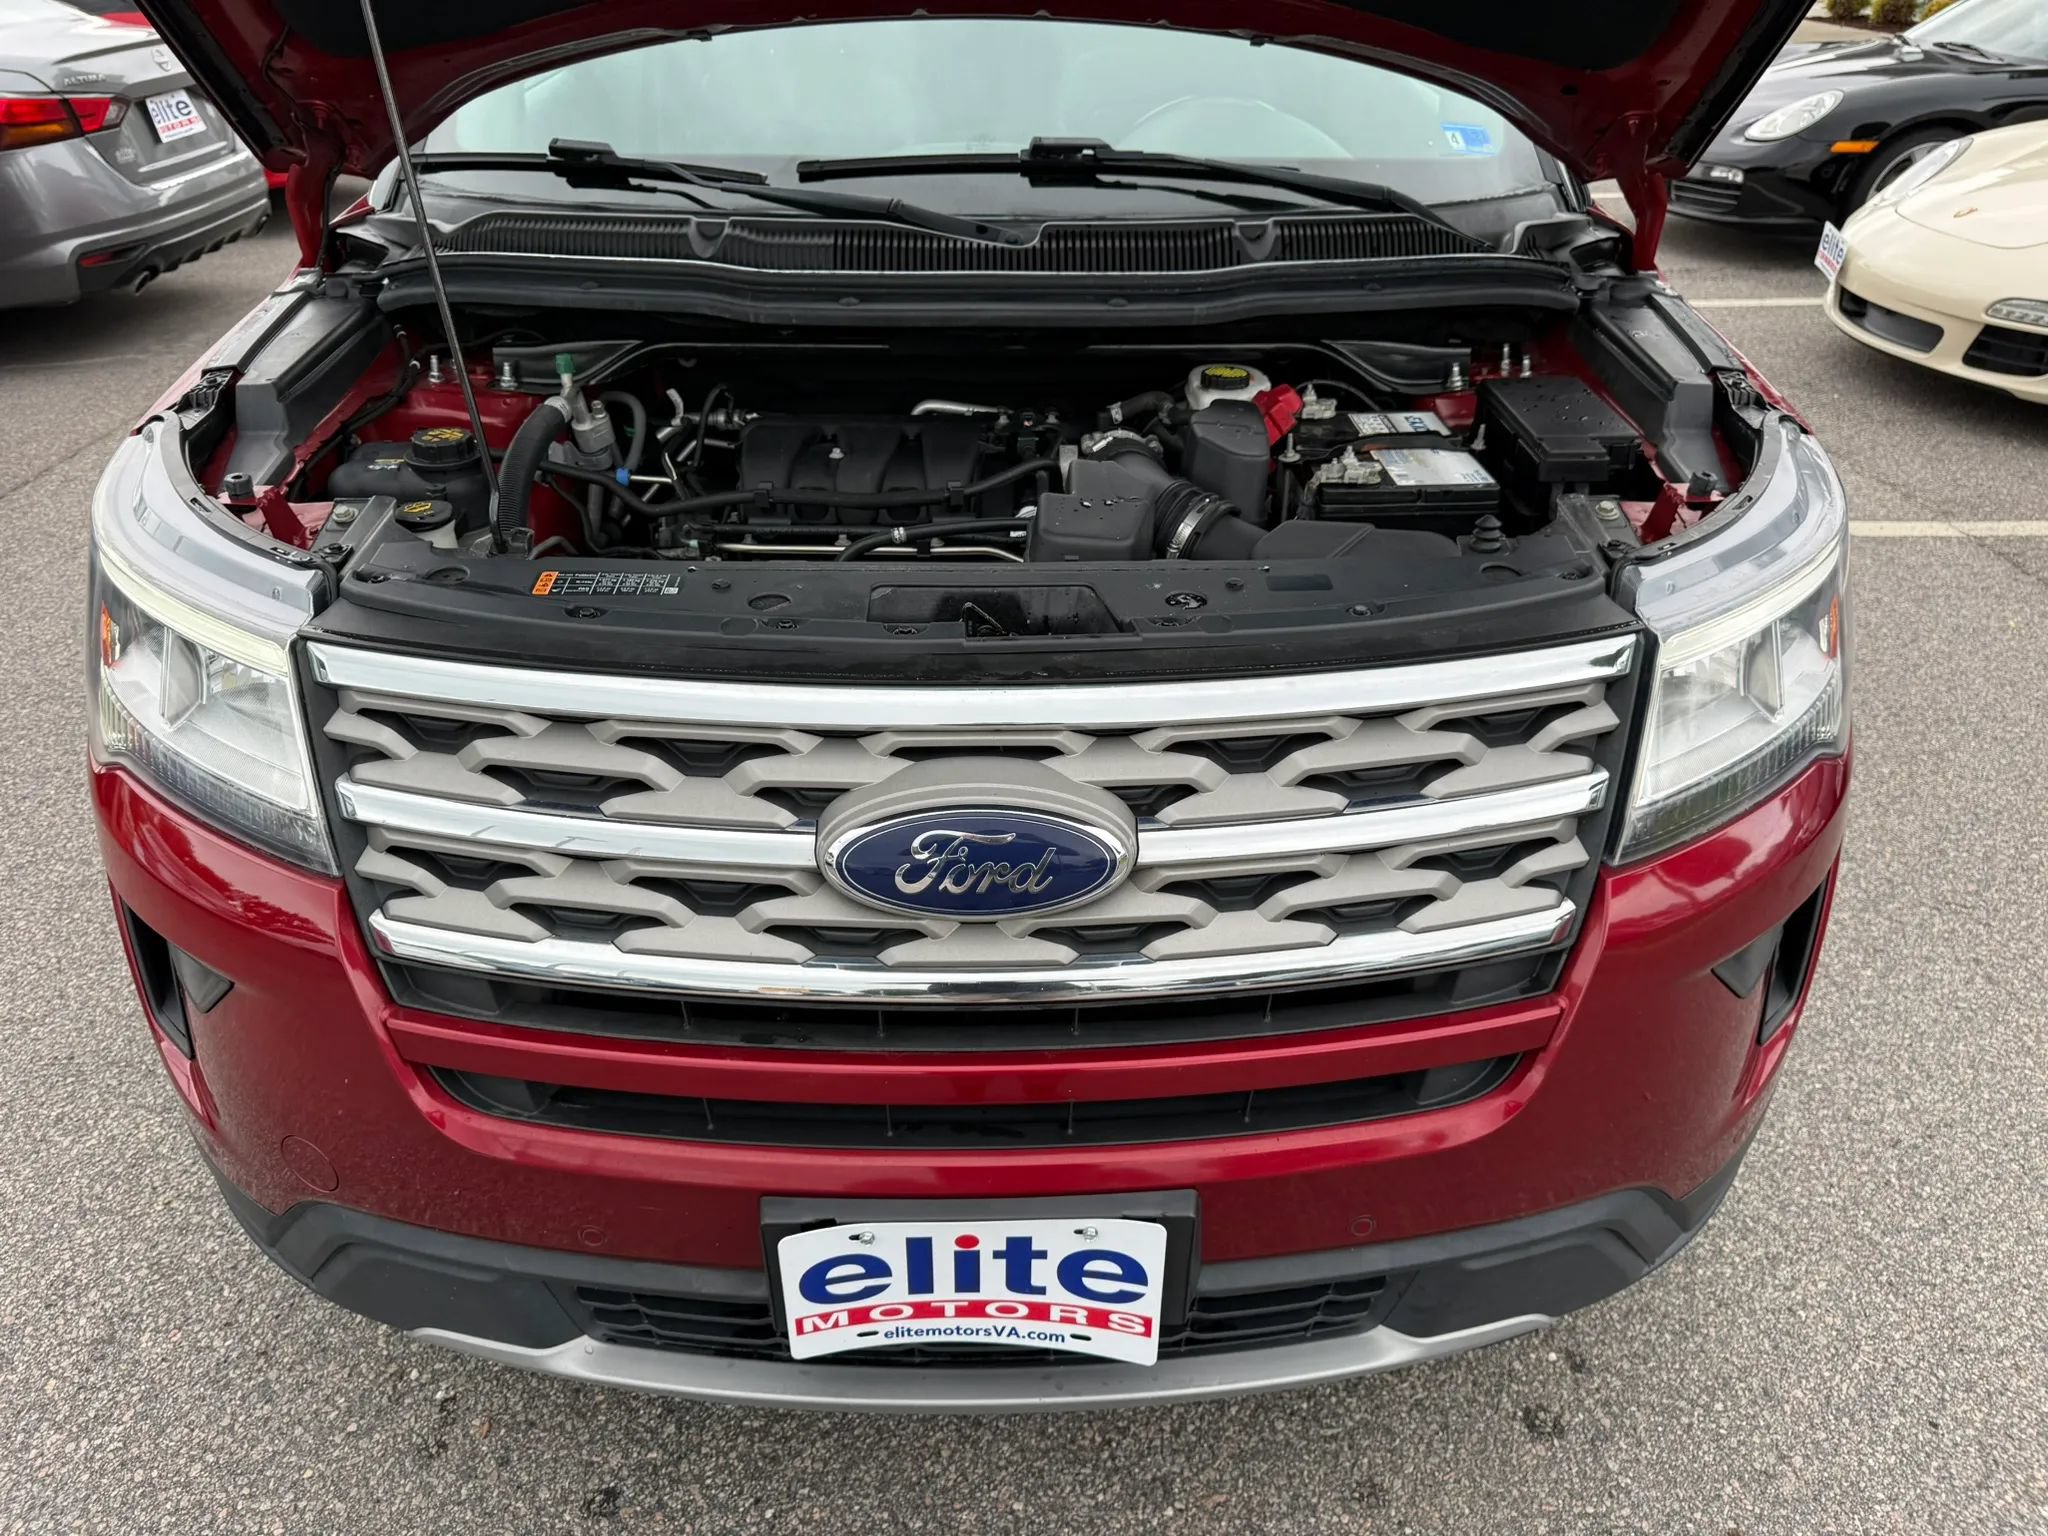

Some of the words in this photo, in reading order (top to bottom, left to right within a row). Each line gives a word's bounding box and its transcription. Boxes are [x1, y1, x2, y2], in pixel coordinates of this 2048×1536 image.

[150, 99, 193, 125] elite
[1822, 232, 1844, 265] elite
[894, 829, 1057, 895] Ford
[799, 1234, 1149, 1304] elite
[801, 1301, 1146, 1335] MOTORS
[883, 1325, 1066, 1344] elitemotorsVA.com
